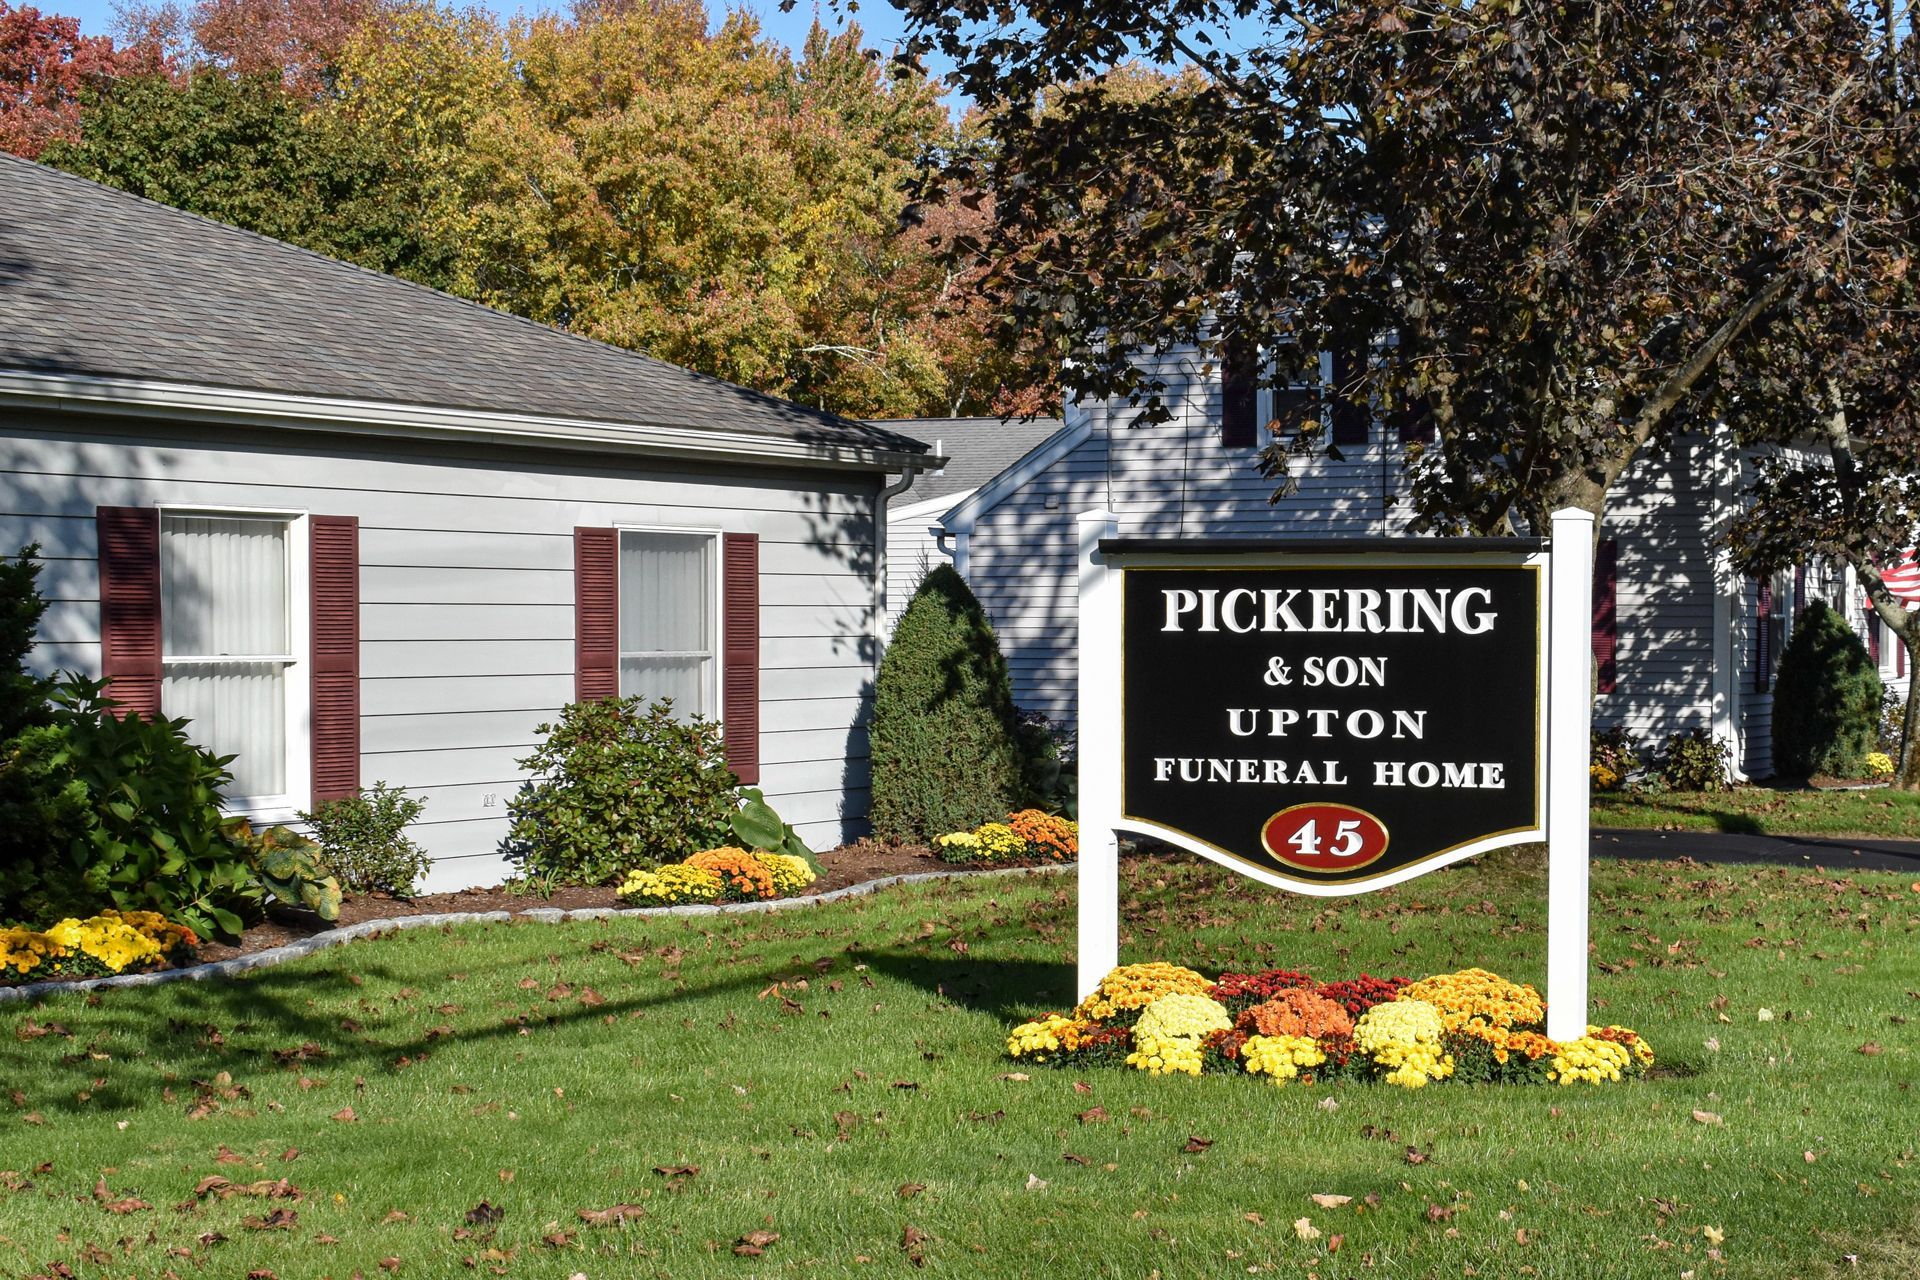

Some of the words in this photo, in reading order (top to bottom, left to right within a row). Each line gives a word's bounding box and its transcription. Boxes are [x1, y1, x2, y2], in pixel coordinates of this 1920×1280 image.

[1160, 587, 1498, 635] PICKERING
[1263, 656, 1293, 686] &
[1303, 656, 1389, 687] SON
[1226, 708, 1428, 740] UPTON
[1153, 757, 1348, 785] FUNERAL
[1372, 761, 1506, 789] HOME
[1287, 819, 1364, 857] 45
